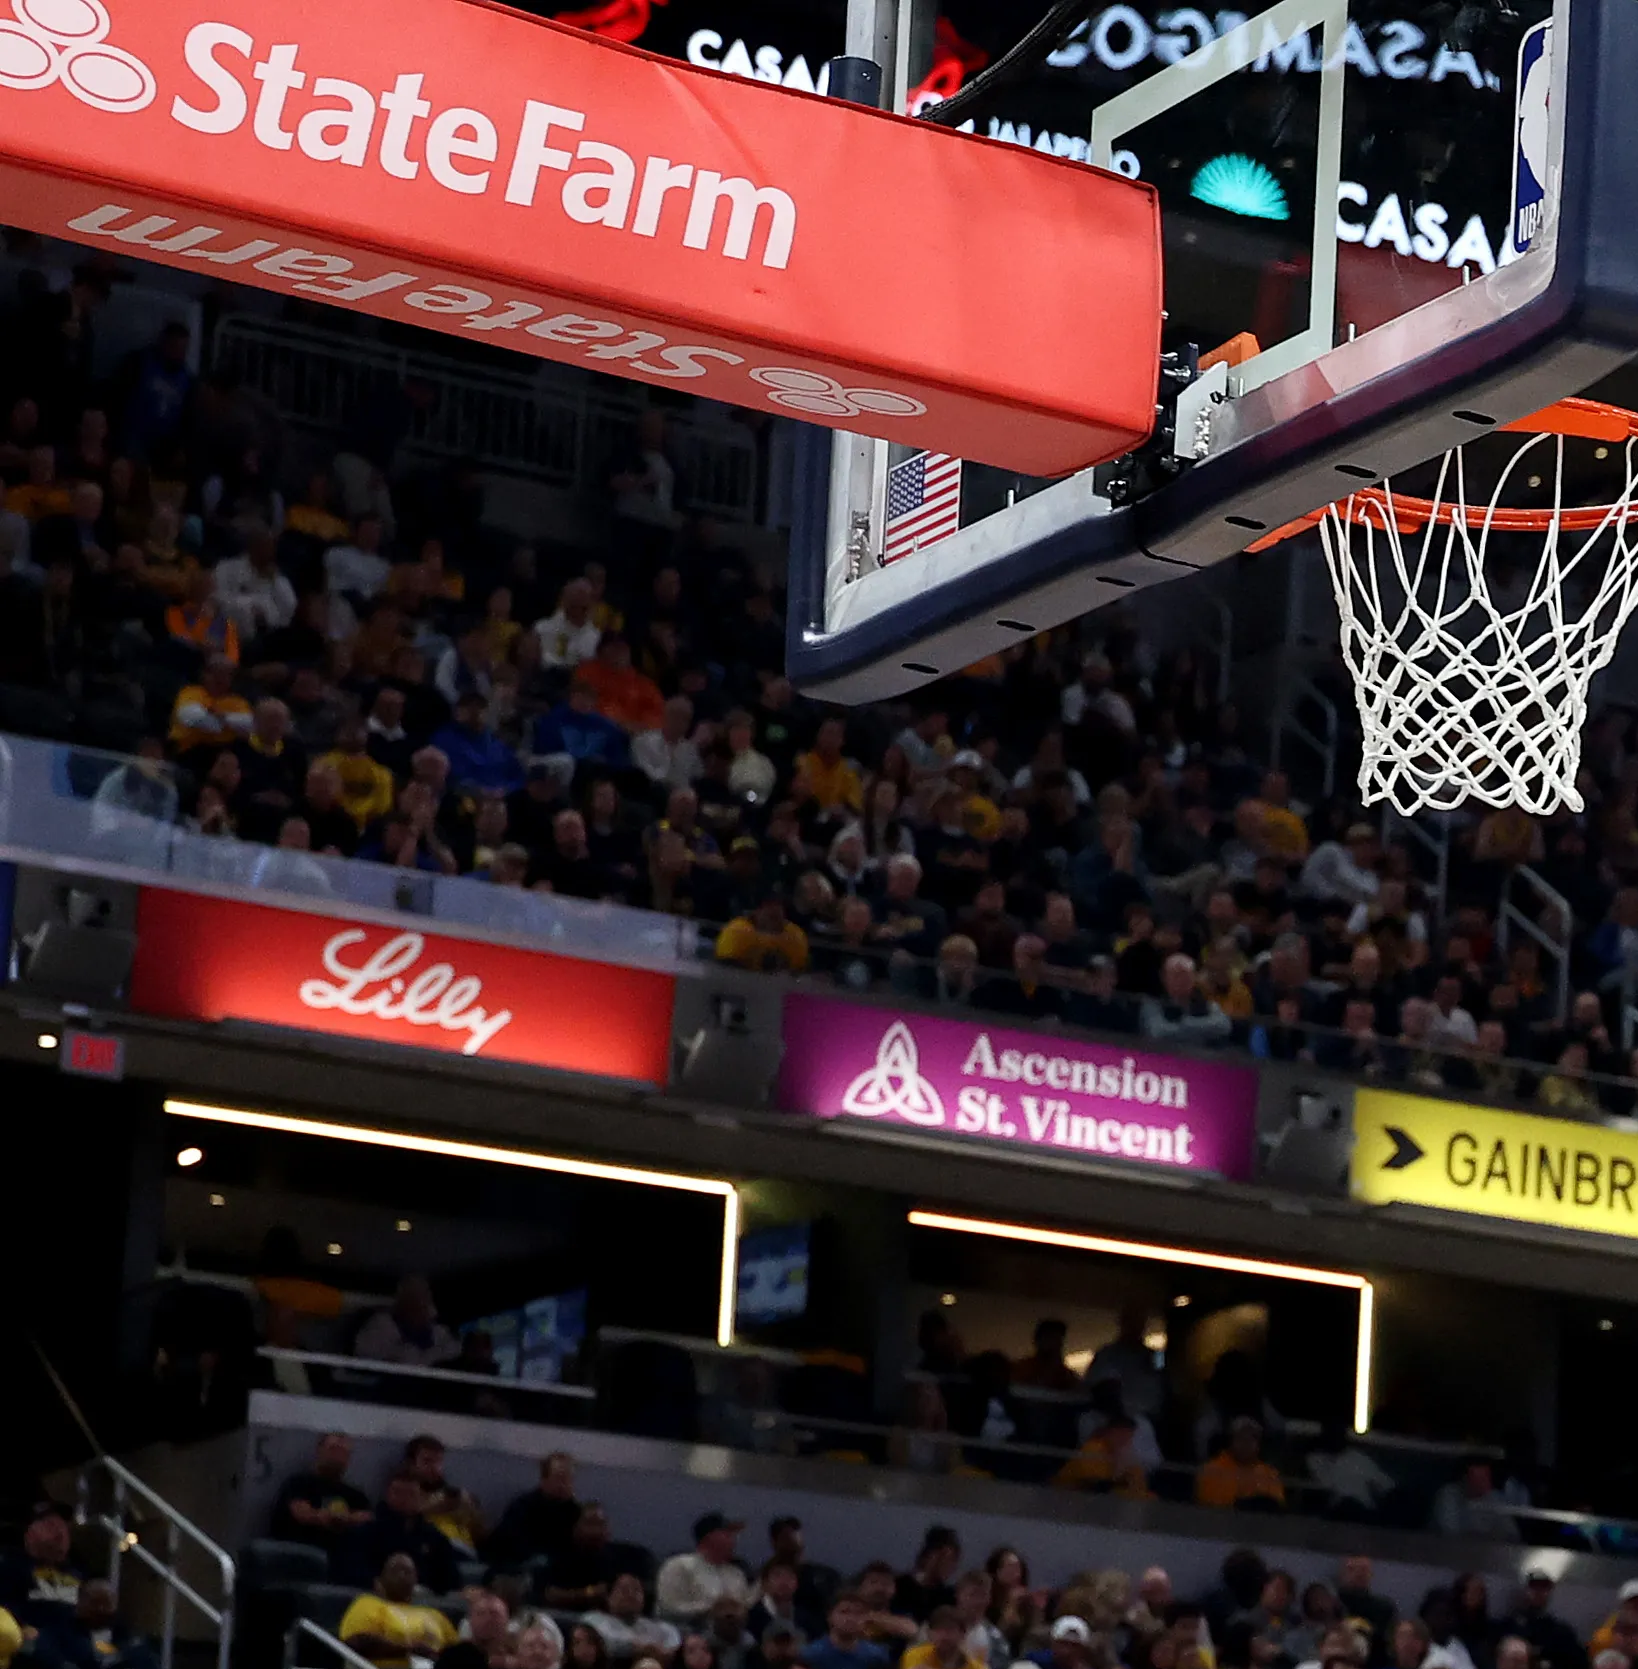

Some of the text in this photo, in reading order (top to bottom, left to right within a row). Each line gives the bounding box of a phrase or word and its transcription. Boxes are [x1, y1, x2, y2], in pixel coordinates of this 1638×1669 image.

[299, 929, 512, 1057] Lilly
[961, 1033, 1188, 1110] Ascension
[954, 1086, 1194, 1165] St. Vincent
